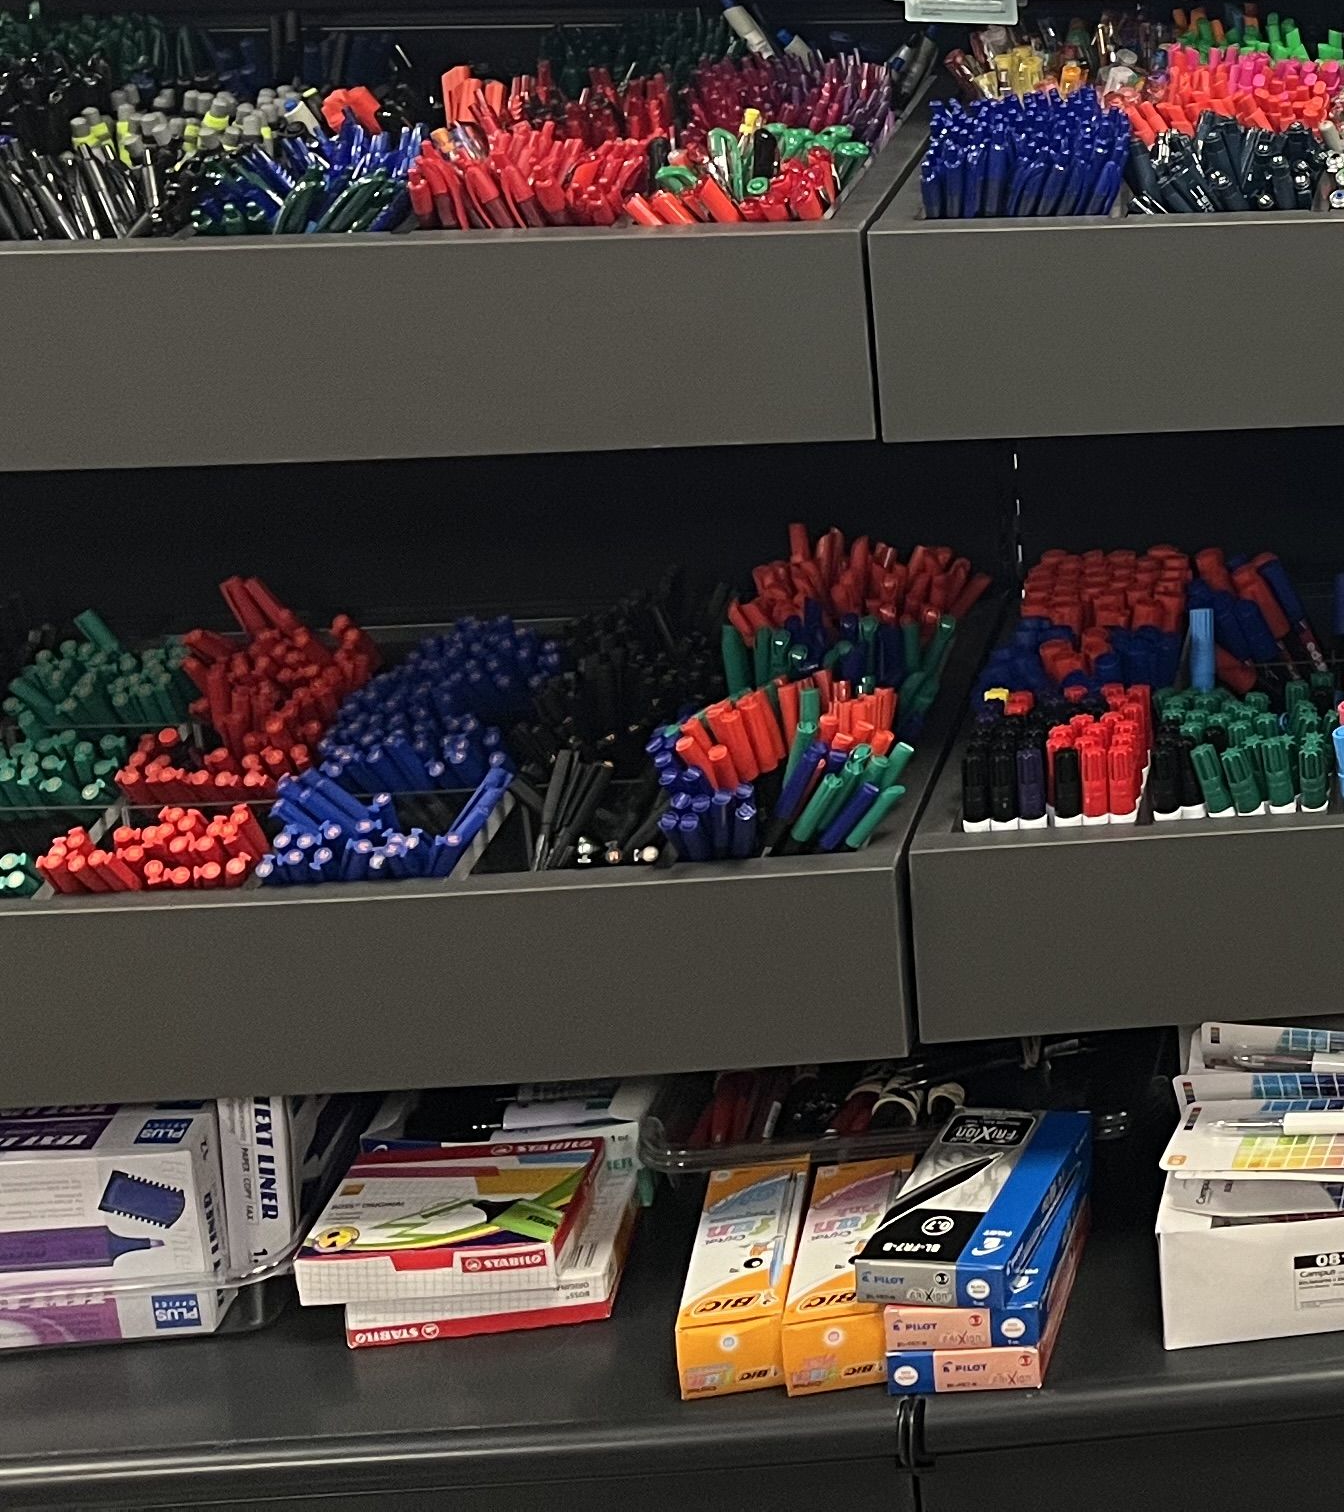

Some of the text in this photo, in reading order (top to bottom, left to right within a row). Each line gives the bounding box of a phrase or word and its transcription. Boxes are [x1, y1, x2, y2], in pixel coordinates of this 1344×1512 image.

[140, 1127, 185, 1139] PLUS
[515, 1139, 594, 1154] STABILO
[240, 1147, 250, 1175] PAPER
[257, 1154, 279, 1221] LINER
[926, 1218, 950, 1234] 0.7
[483, 1253, 542, 1269] STABILO
[874, 1275, 905, 1285] PILOT
[1299, 1269, 1337, 1278] Campus
[699, 1295, 756, 1312] BIC
[155, 1308, 200, 1322] PLUS
[905, 1322, 938, 1332] PILOT
[354, 1328, 420, 1344] STABILO
[955, 1363, 988, 1372] PILOT
